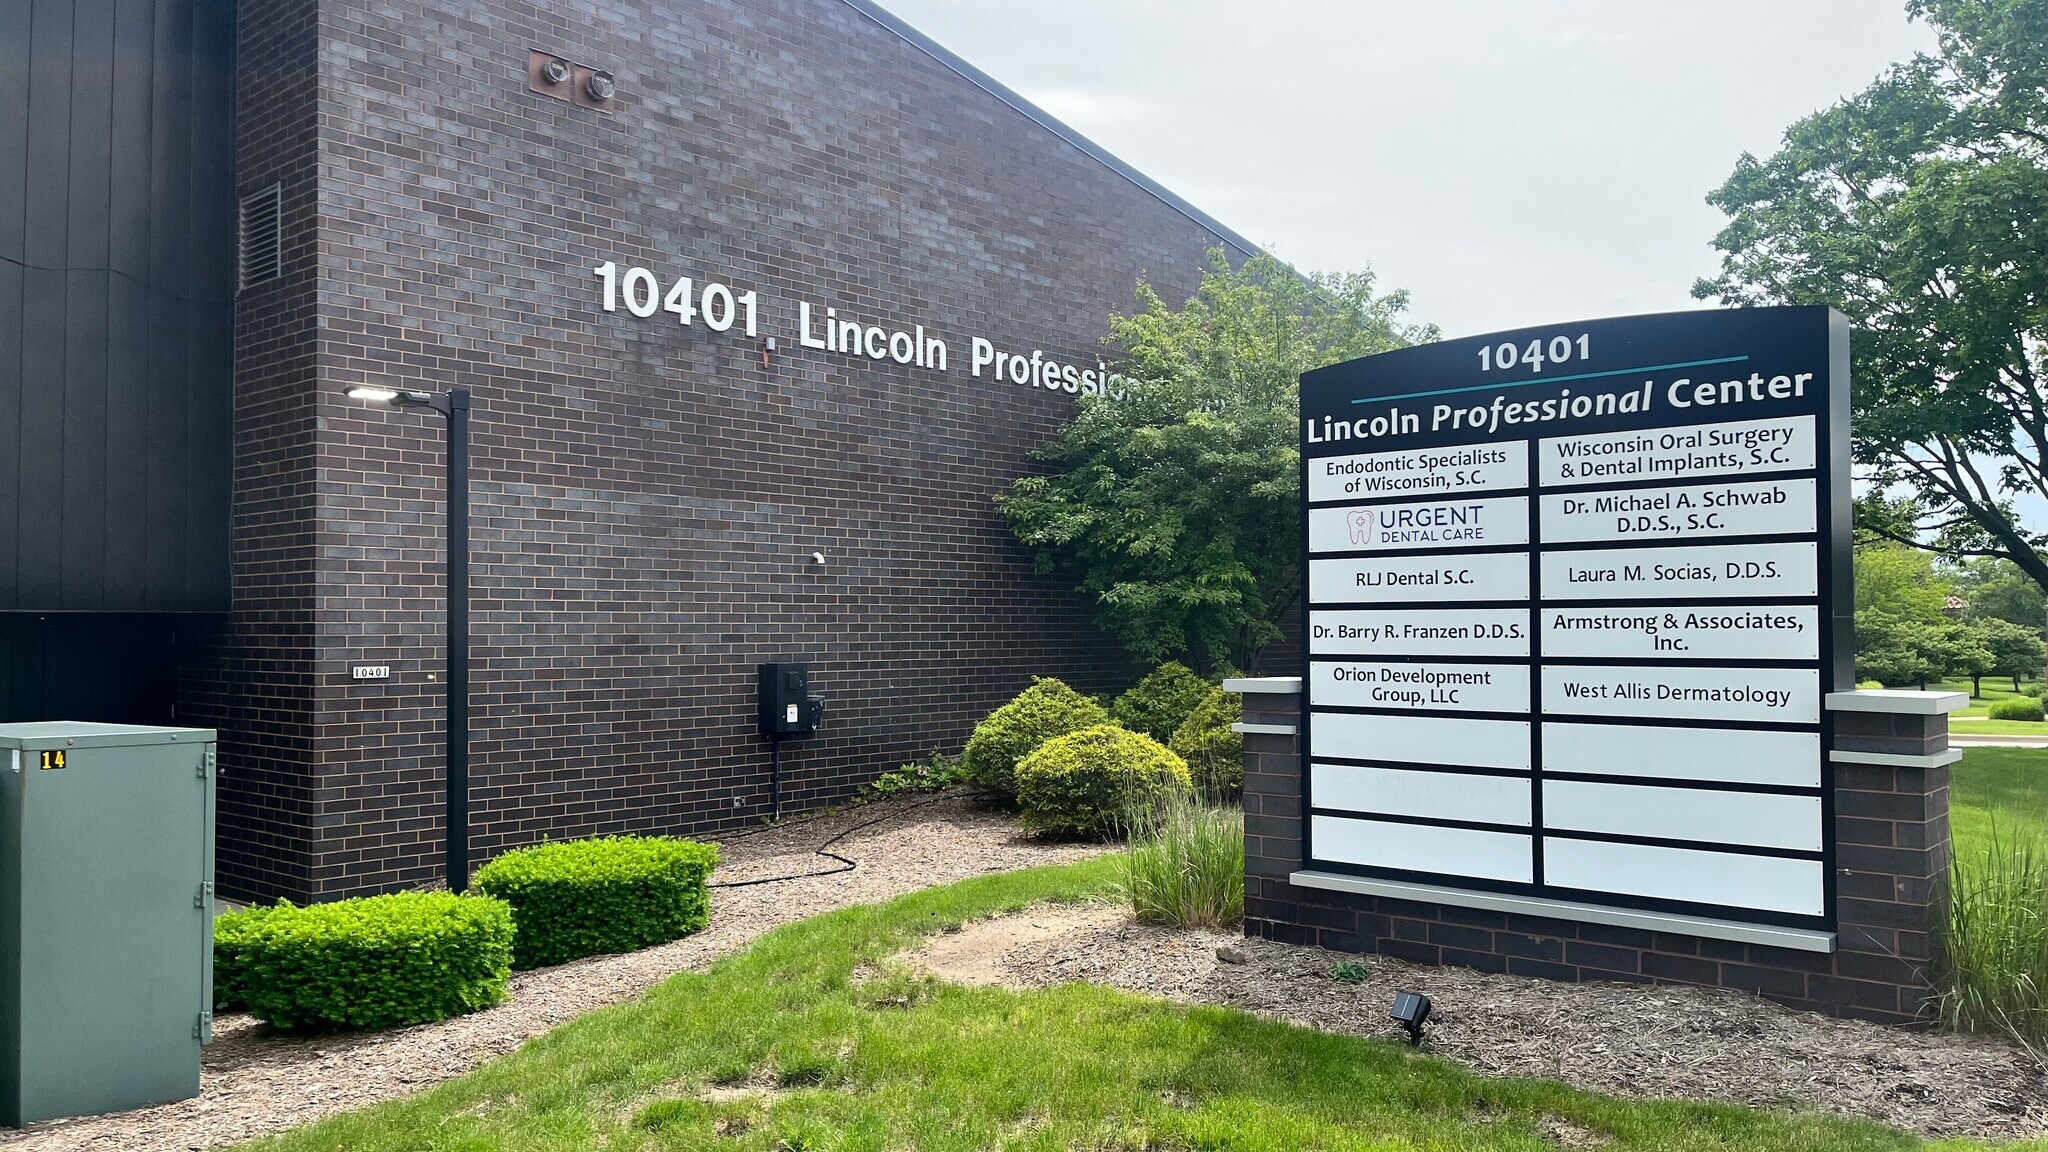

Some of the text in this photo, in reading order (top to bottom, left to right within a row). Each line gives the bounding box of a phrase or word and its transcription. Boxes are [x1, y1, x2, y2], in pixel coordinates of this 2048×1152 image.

[594, 260, 758, 338] 10401
[799, 301, 948, 372] Lincoln
[1477, 333, 1589, 373] 10401
[1308, 372, 1813, 443] Lincoln Professional Center
[1556, 427, 1794, 458] Wisconsin Oral Surgery
[1326, 449, 1506, 476] Endodontic Specialists
[1560, 446, 1790, 479] & Dental Implants, S.C.
[1344, 469, 1486, 493] of Wisconsin, S.C.
[1563, 486, 1787, 515] Dr. Michael A. Schwab
[1380, 505, 1484, 529] URGENT
[1617, 512, 1725, 535] D.D.S., S.C.
[1380, 527, 1485, 543] DENTAL CARE
[1356, 569, 1474, 587] RLJ Dental S.C.
[1569, 561, 1781, 583] Laura M. Socias, D.D.S.
[1313, 623, 1525, 643] Dr. Barry R. Franzen D.D.S.
[1553, 611, 1804, 635] Armstrong & Associates,
[1654, 634, 1689, 651] Inc.
[355, 667, 387, 678] 10401
[1333, 666, 1492, 689] Orion Development
[1371, 686, 1460, 707] Group, LLC
[1563, 682, 1792, 708] West Allis Dermatology
[42, 750, 65, 769] 14
